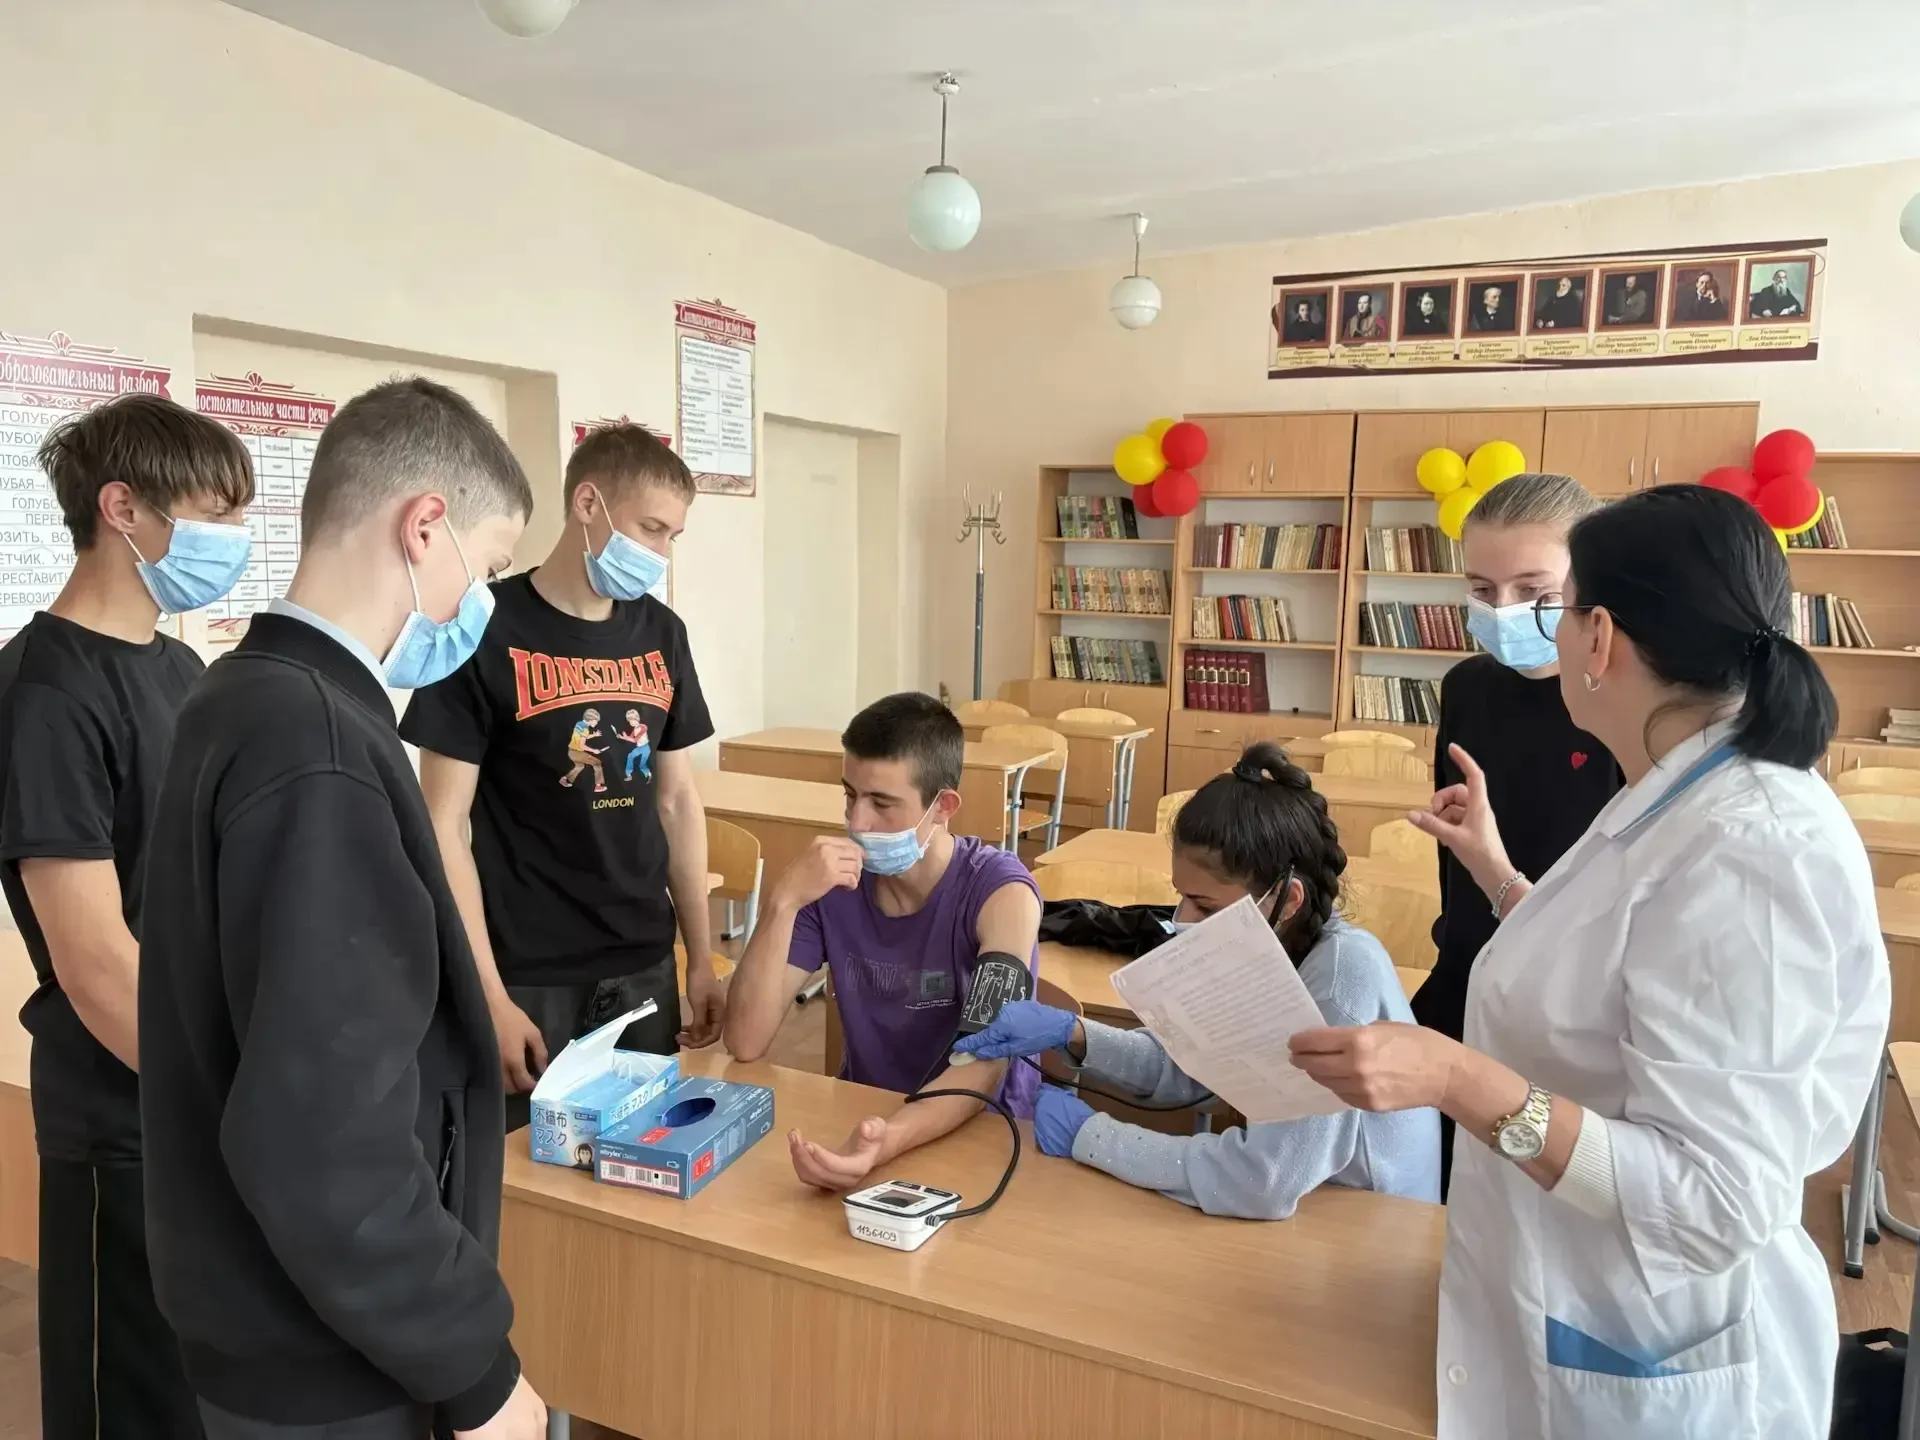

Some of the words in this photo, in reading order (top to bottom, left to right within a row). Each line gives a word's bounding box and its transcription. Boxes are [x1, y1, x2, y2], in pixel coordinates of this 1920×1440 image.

[2, 410, 66, 425] ГОЛУБО
[276, 403, 306, 421] части
[308, 403, 329, 429] речи
[0, 477, 34, 489] УБАЯ
[0, 572, 68, 585] РЕСТАВИТ
[508, 647, 674, 721] LONSDALE
[592, 796, 635, 810] LONDON
[535, 1127, 567, 1147] マスク
